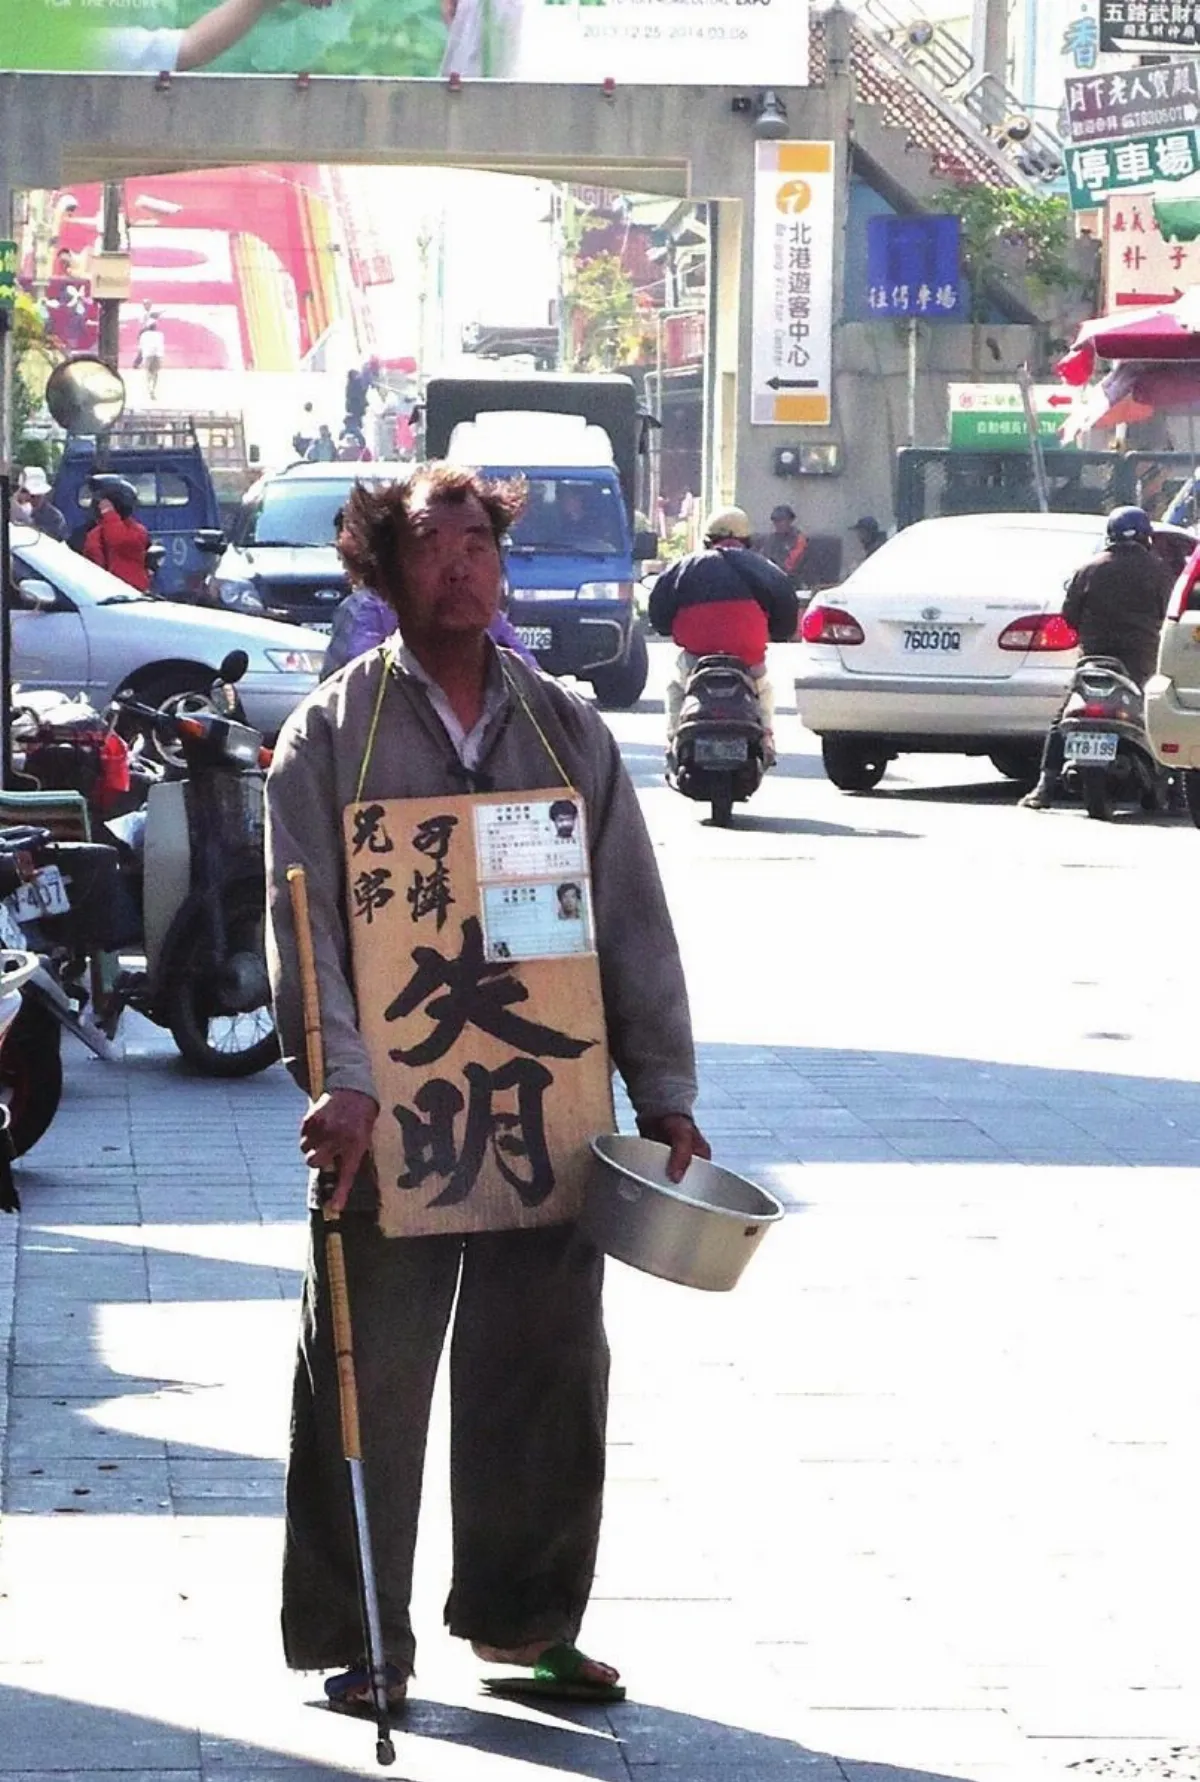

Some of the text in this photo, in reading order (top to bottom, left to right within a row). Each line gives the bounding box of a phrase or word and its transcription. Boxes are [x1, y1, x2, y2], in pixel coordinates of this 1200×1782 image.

[1071, 135, 1194, 190] 停車場
[787, 221, 812, 367] 北港遊客中心
[352, 803, 395, 925] 兄弟
[406, 814, 459, 934] 可憐
[384, 914, 601, 1208] 失明
